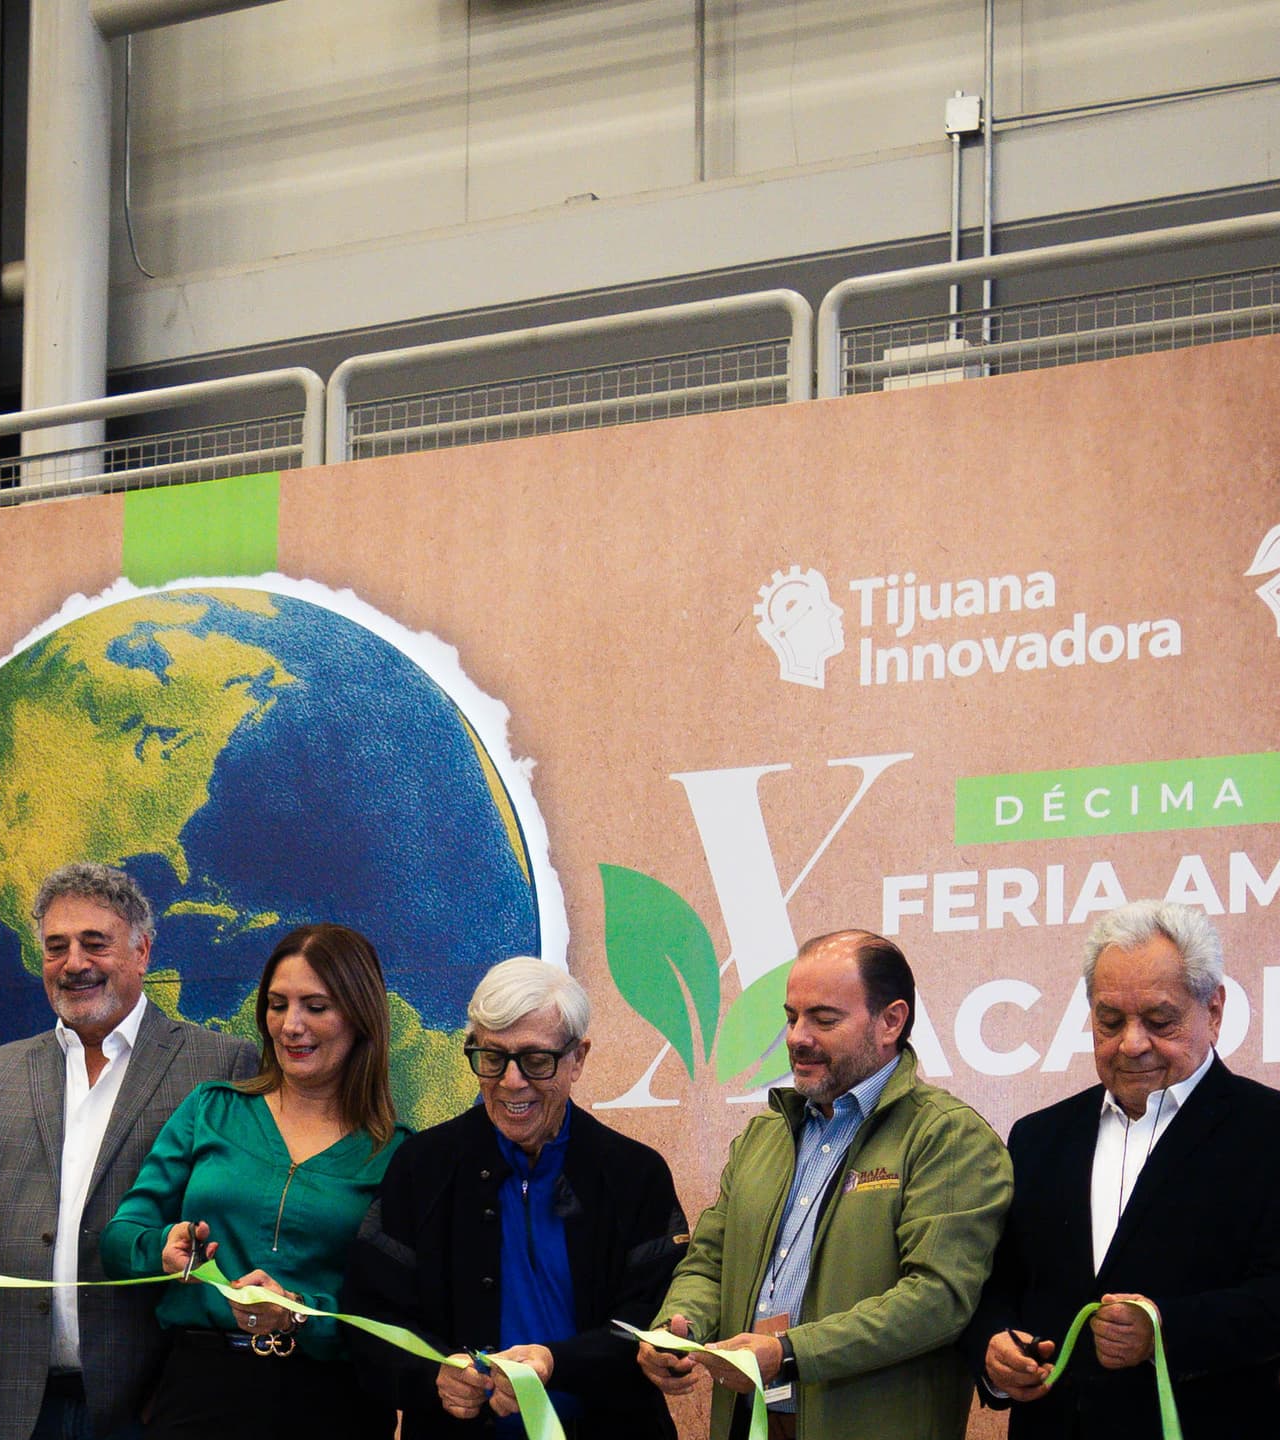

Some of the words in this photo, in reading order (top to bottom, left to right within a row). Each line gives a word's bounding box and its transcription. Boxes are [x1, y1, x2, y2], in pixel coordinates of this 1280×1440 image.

[850, 566, 1055, 636] Tijuana
[860, 613, 1182, 686] Innovadora
[995, 777, 1244, 826] DÉCIMA
[882, 862, 1126, 935] FERIA
